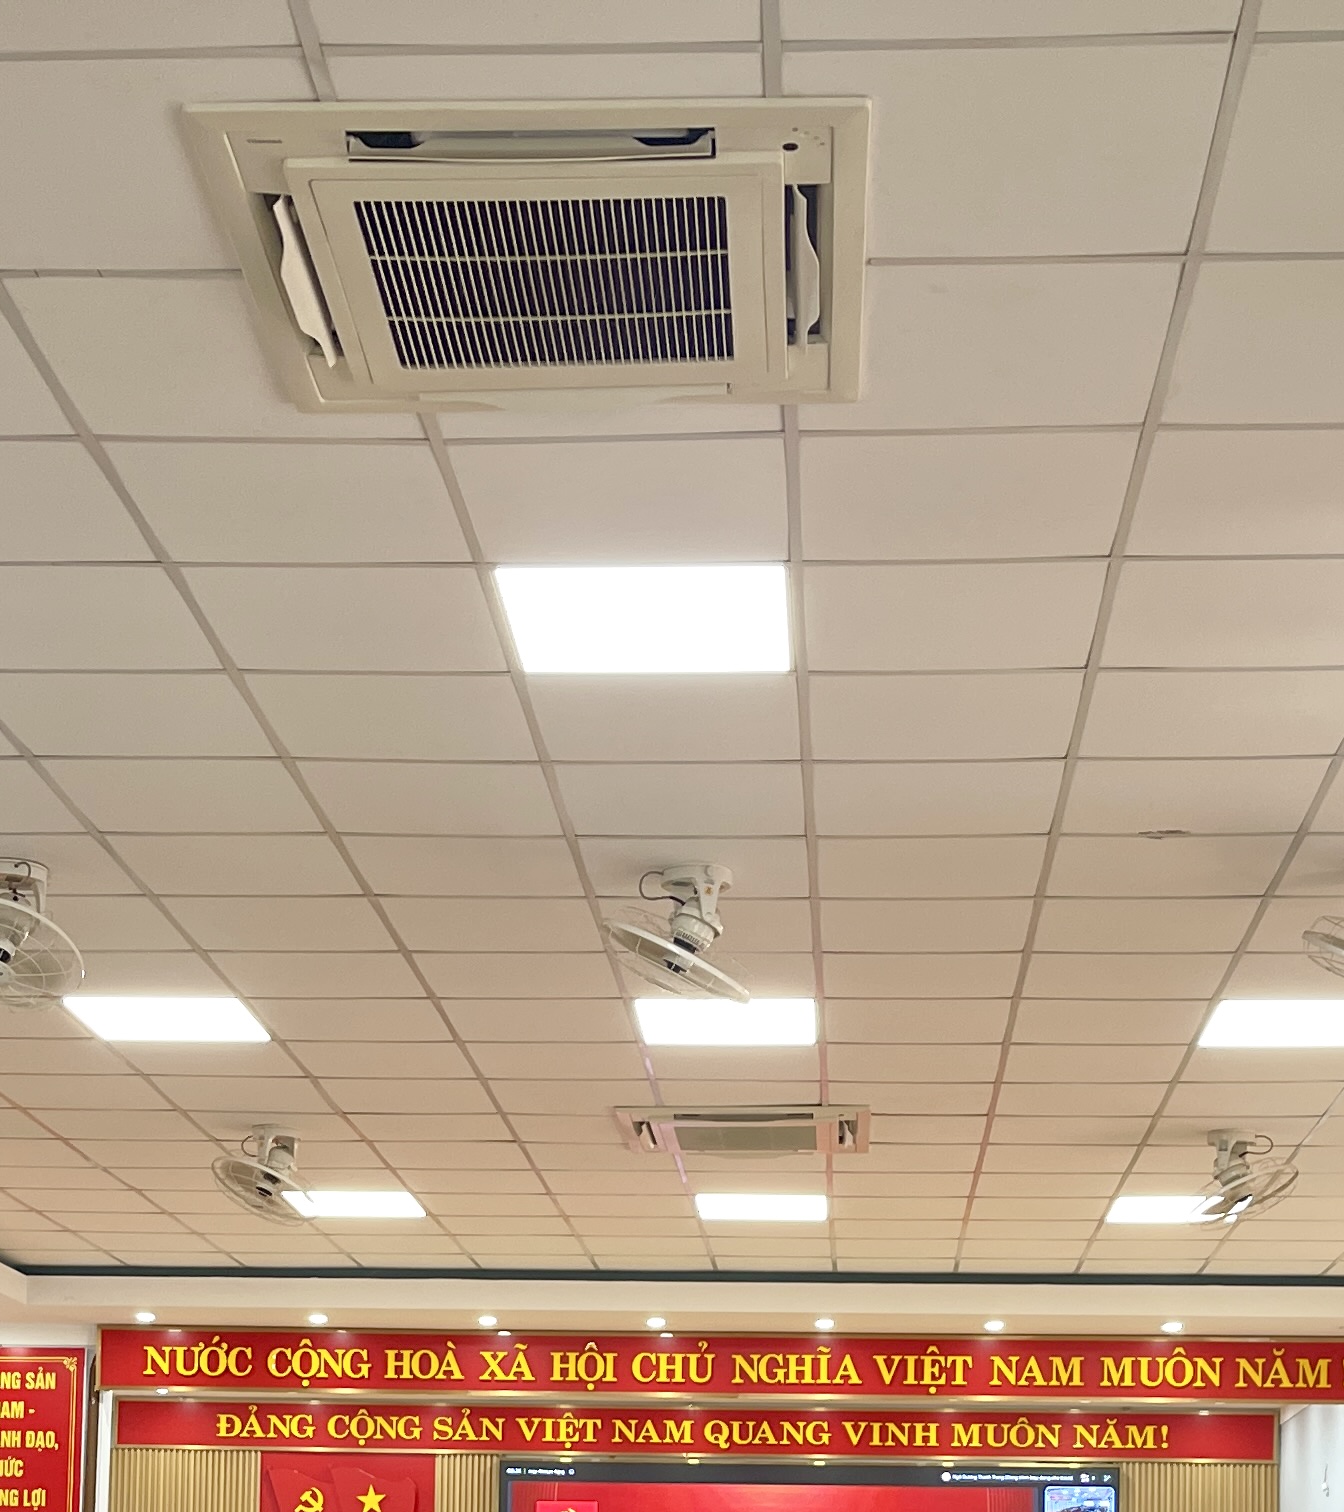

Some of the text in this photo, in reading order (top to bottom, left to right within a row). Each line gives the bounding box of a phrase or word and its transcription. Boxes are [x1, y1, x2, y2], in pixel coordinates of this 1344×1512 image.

[143, 1335, 1329, 1391] NƯỚC CỘNG HOÀ XÃ HỘI CHỦ NGHĨA VIỆT NAM MUÔN NĂM
[25, 1366, 56, 1390] SẢN
[216, 1406, 1167, 1448] ĐẢNG CỘNG SẢN VIỆT NAM QUANG VINH MUÔN NĂM!
[25, 1430, 58, 1451] ĐẠO,
[23, 1487, 45, 1510] LỢI
